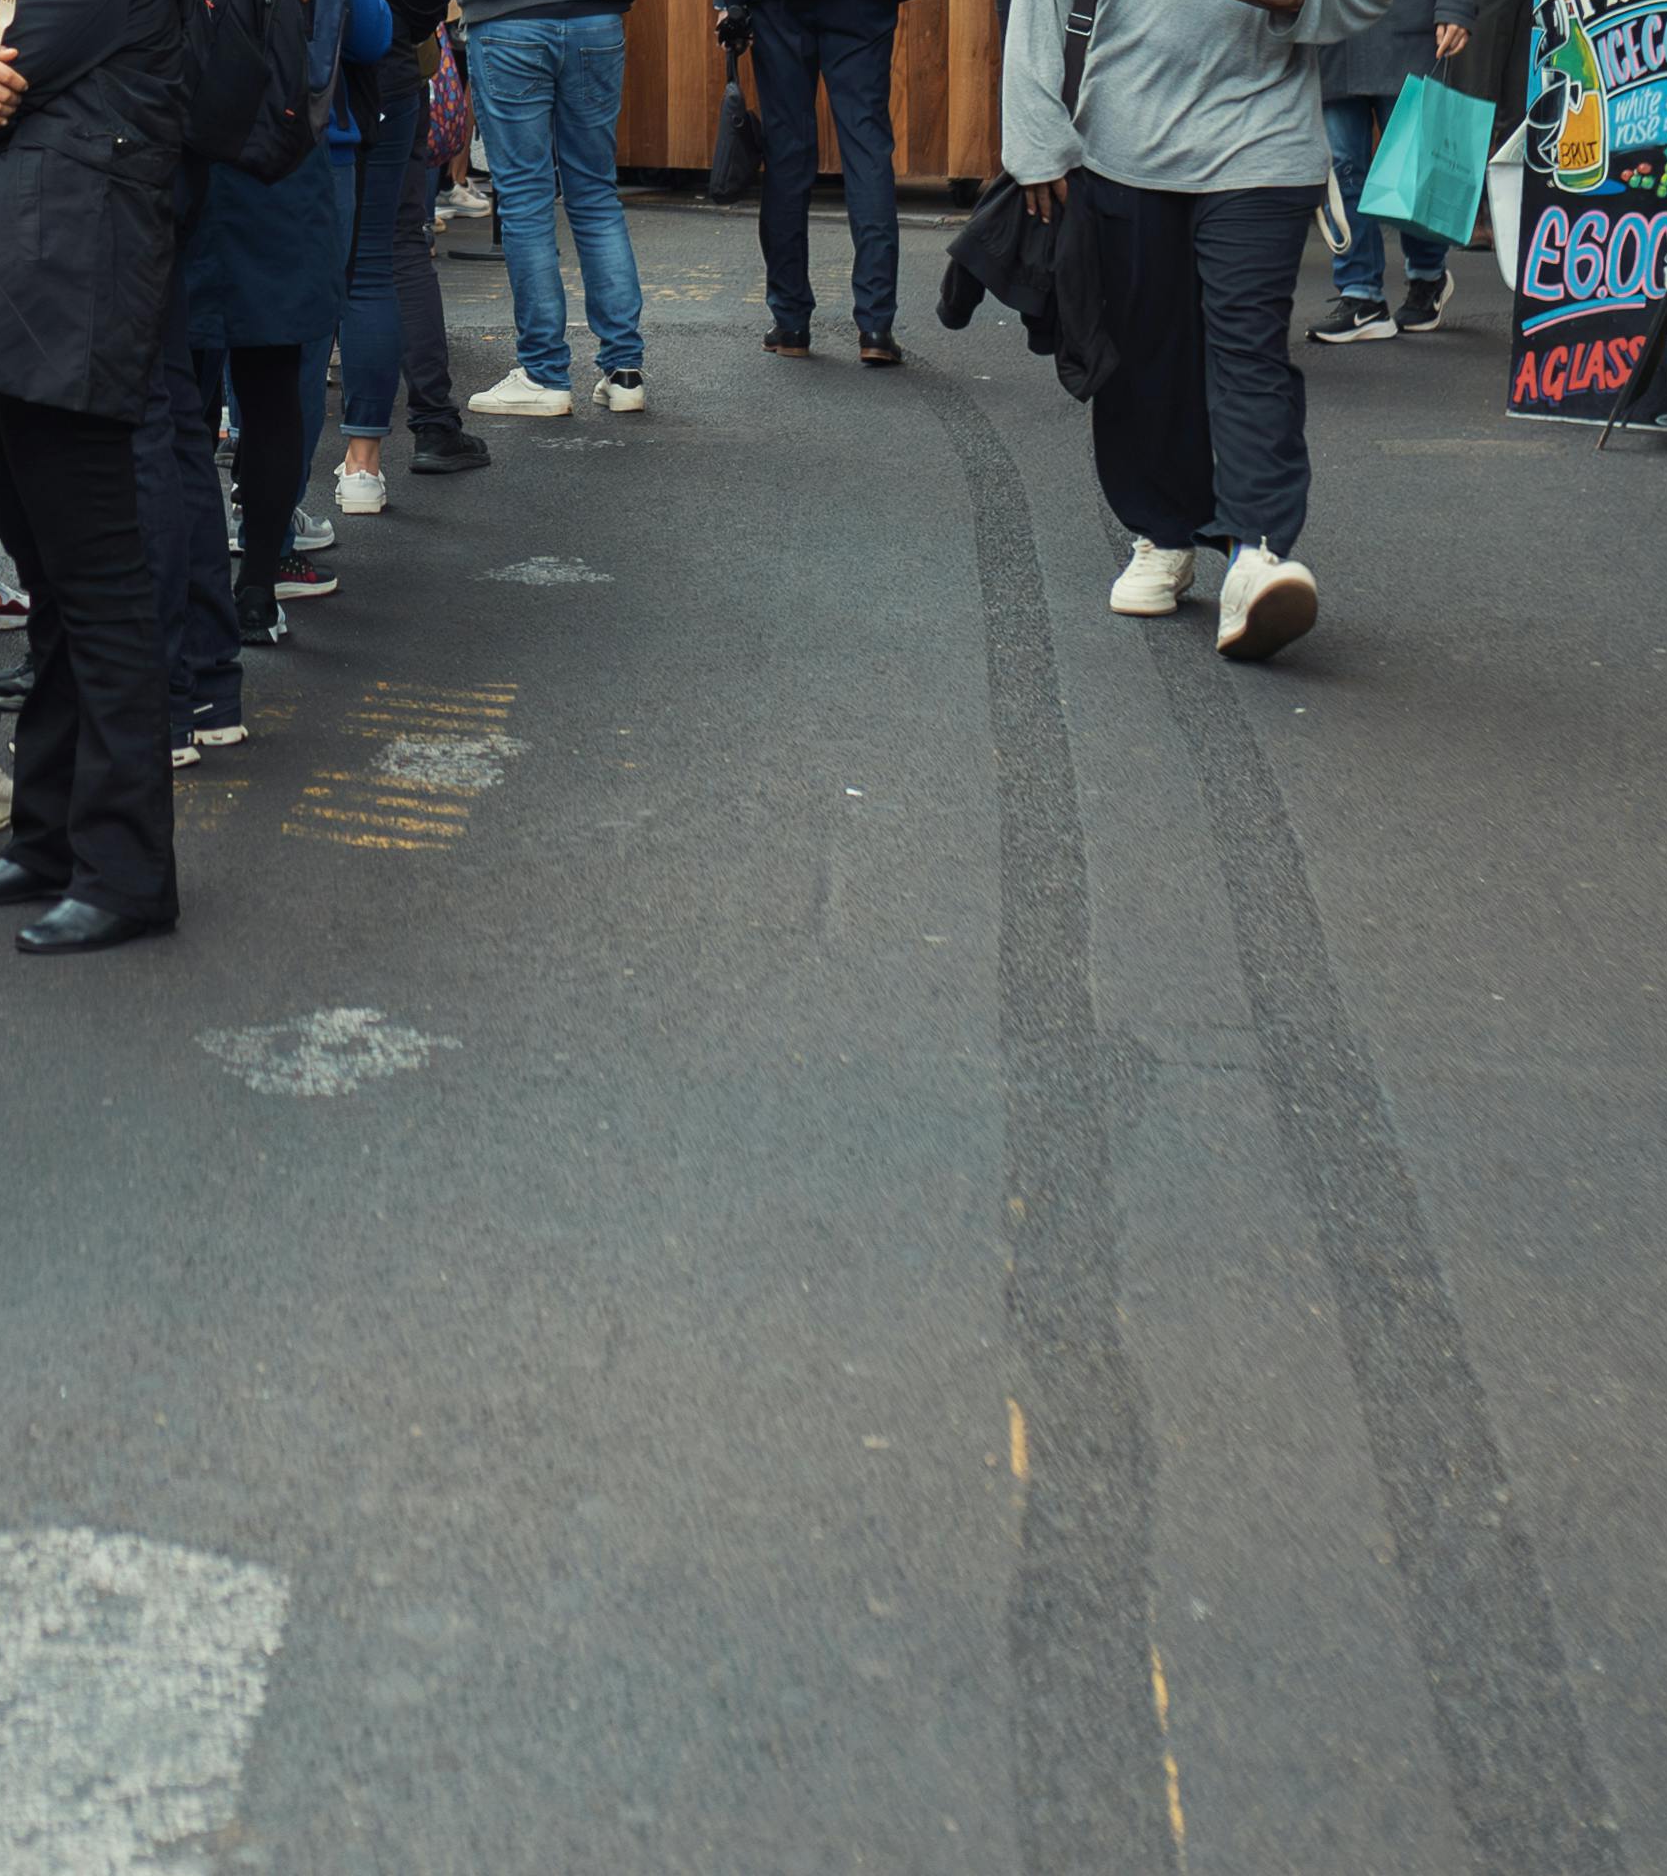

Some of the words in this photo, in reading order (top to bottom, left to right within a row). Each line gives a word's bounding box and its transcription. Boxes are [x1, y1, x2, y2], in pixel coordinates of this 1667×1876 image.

[1596, 17, 1649, 88] ICE
[1615, 86, 1663, 123] white
[1560, 140, 1598, 168] BRUT
[1512, 349, 1539, 405] A
[1541, 334, 1647, 403] GLASS
